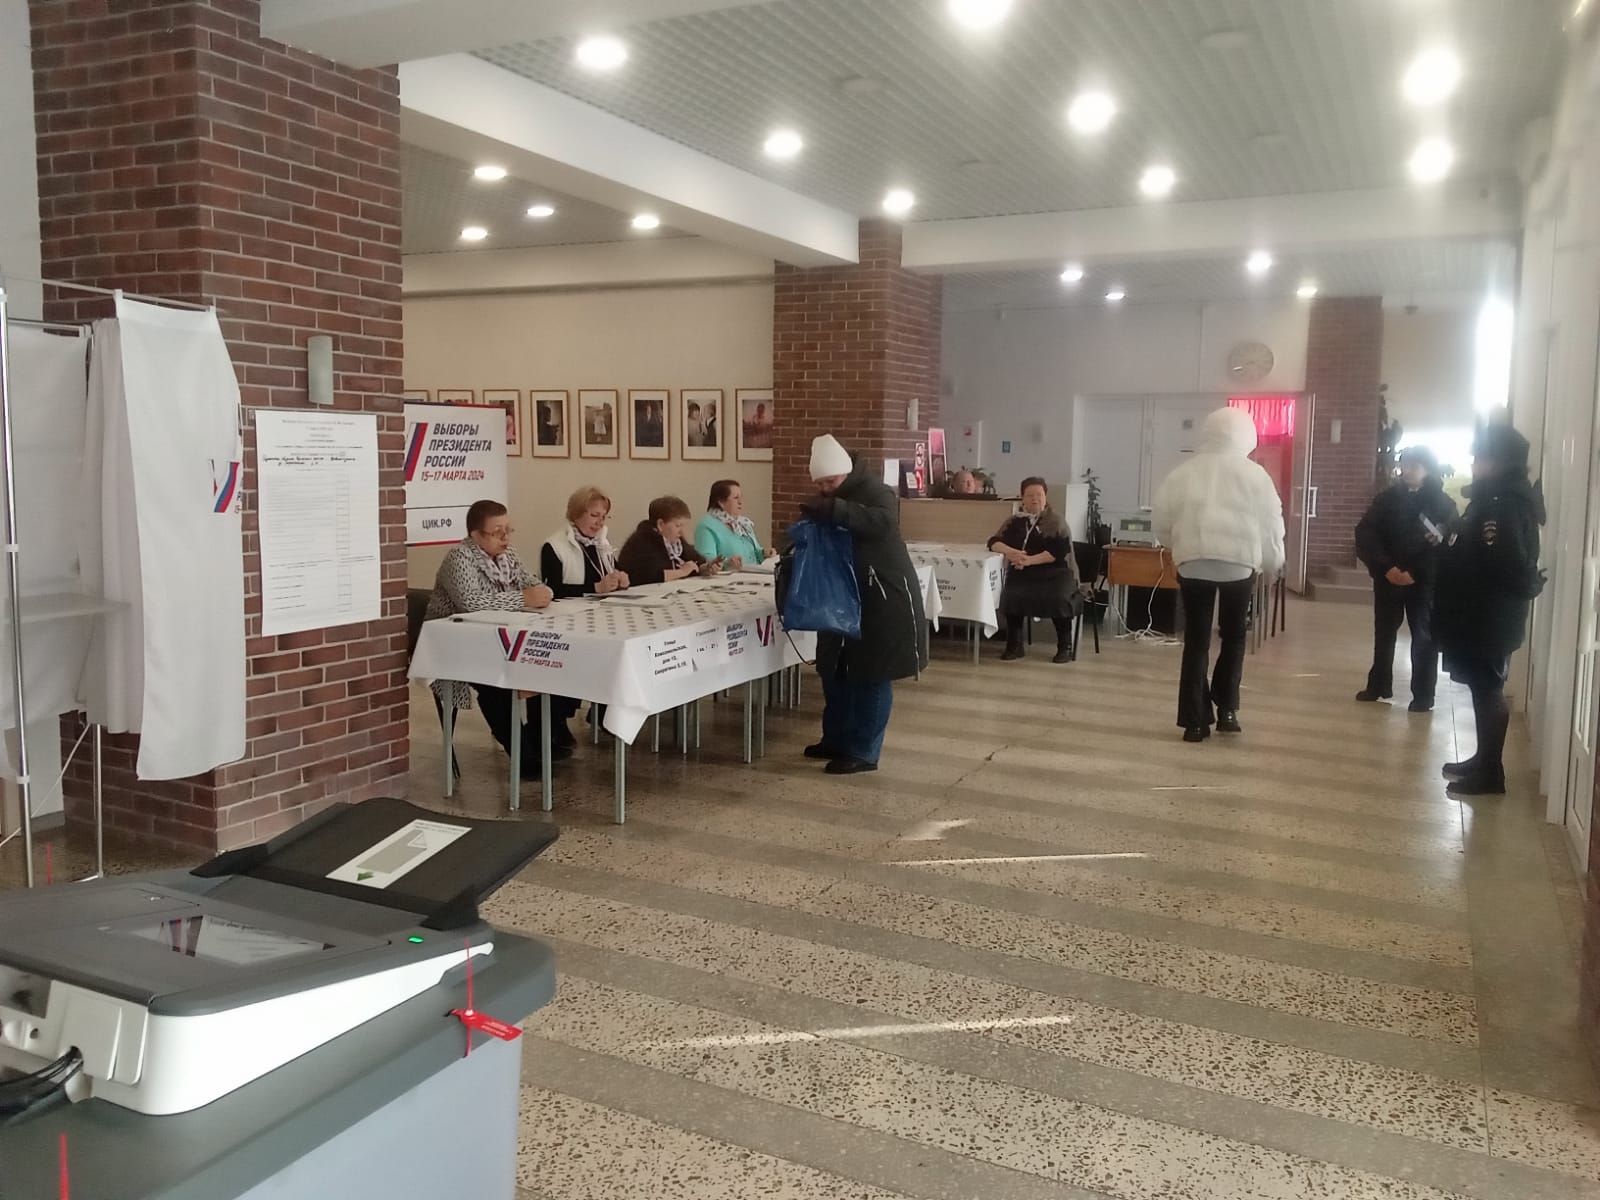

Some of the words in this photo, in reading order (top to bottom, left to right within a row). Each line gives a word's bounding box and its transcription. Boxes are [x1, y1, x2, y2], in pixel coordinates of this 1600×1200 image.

[433, 423, 479, 436] ВЫБОРЫ
[428, 439, 492, 453] ПРЕЗИДЕНТА
[424, 455, 466, 467] РОССИИ
[442, 471, 467, 481] МАРТА
[467, 470, 484, 480] 2024
[422, 518, 452, 530] ЦИК.РФ
[530, 631, 563, 640] ВЫБОРЫ
[526, 638, 570, 651] ПРЕЗИДЕНТА
[523, 647, 551, 658] РОССИИ
